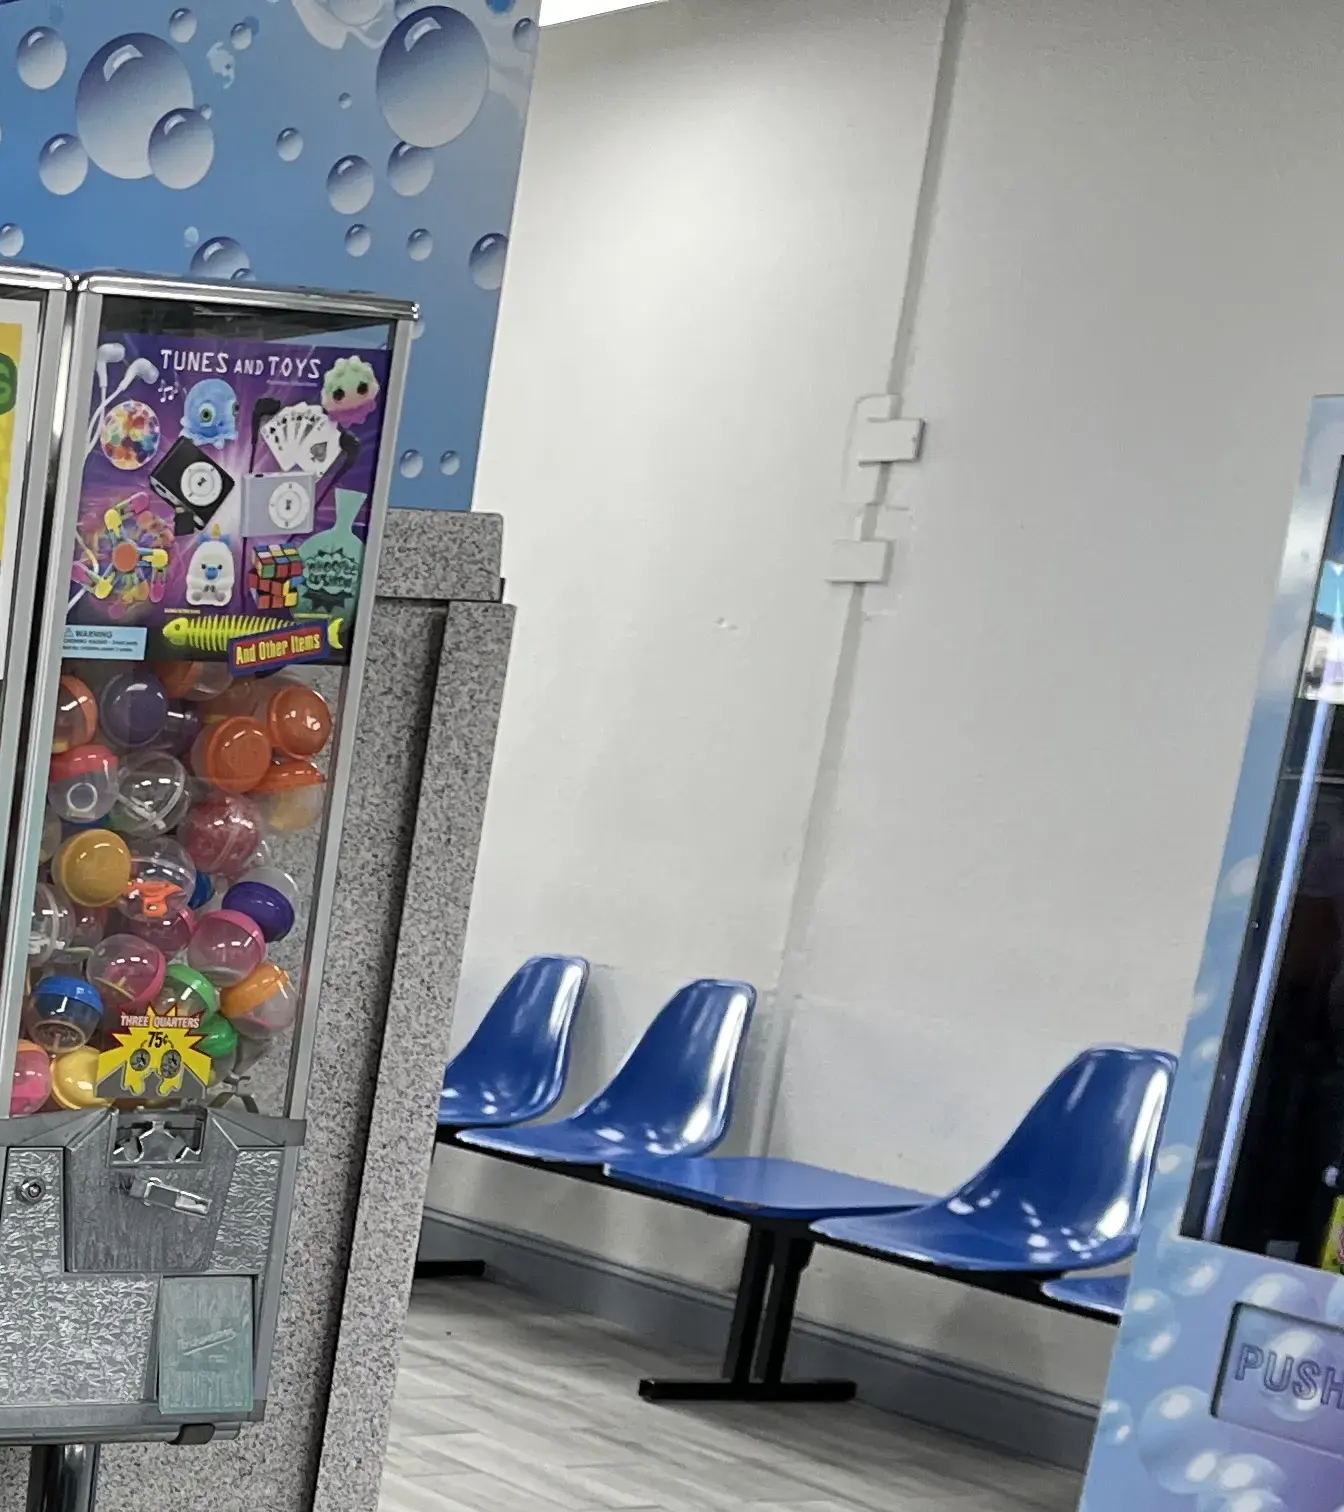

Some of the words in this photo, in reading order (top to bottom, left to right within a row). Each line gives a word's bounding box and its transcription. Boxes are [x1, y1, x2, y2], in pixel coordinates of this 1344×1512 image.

[161, 350, 229, 374] TUNES
[234, 358, 264, 376] AND
[268, 355, 321, 379] TOYS
[236, 645, 257, 666] And
[259, 640, 288, 661] Other
[120, 1015, 149, 1027] THREE
[154, 1016, 200, 1029] QUARTERS
[148, 1031, 170, 1049] 75¢
[1235, 1341, 1344, 1411] PUSH
